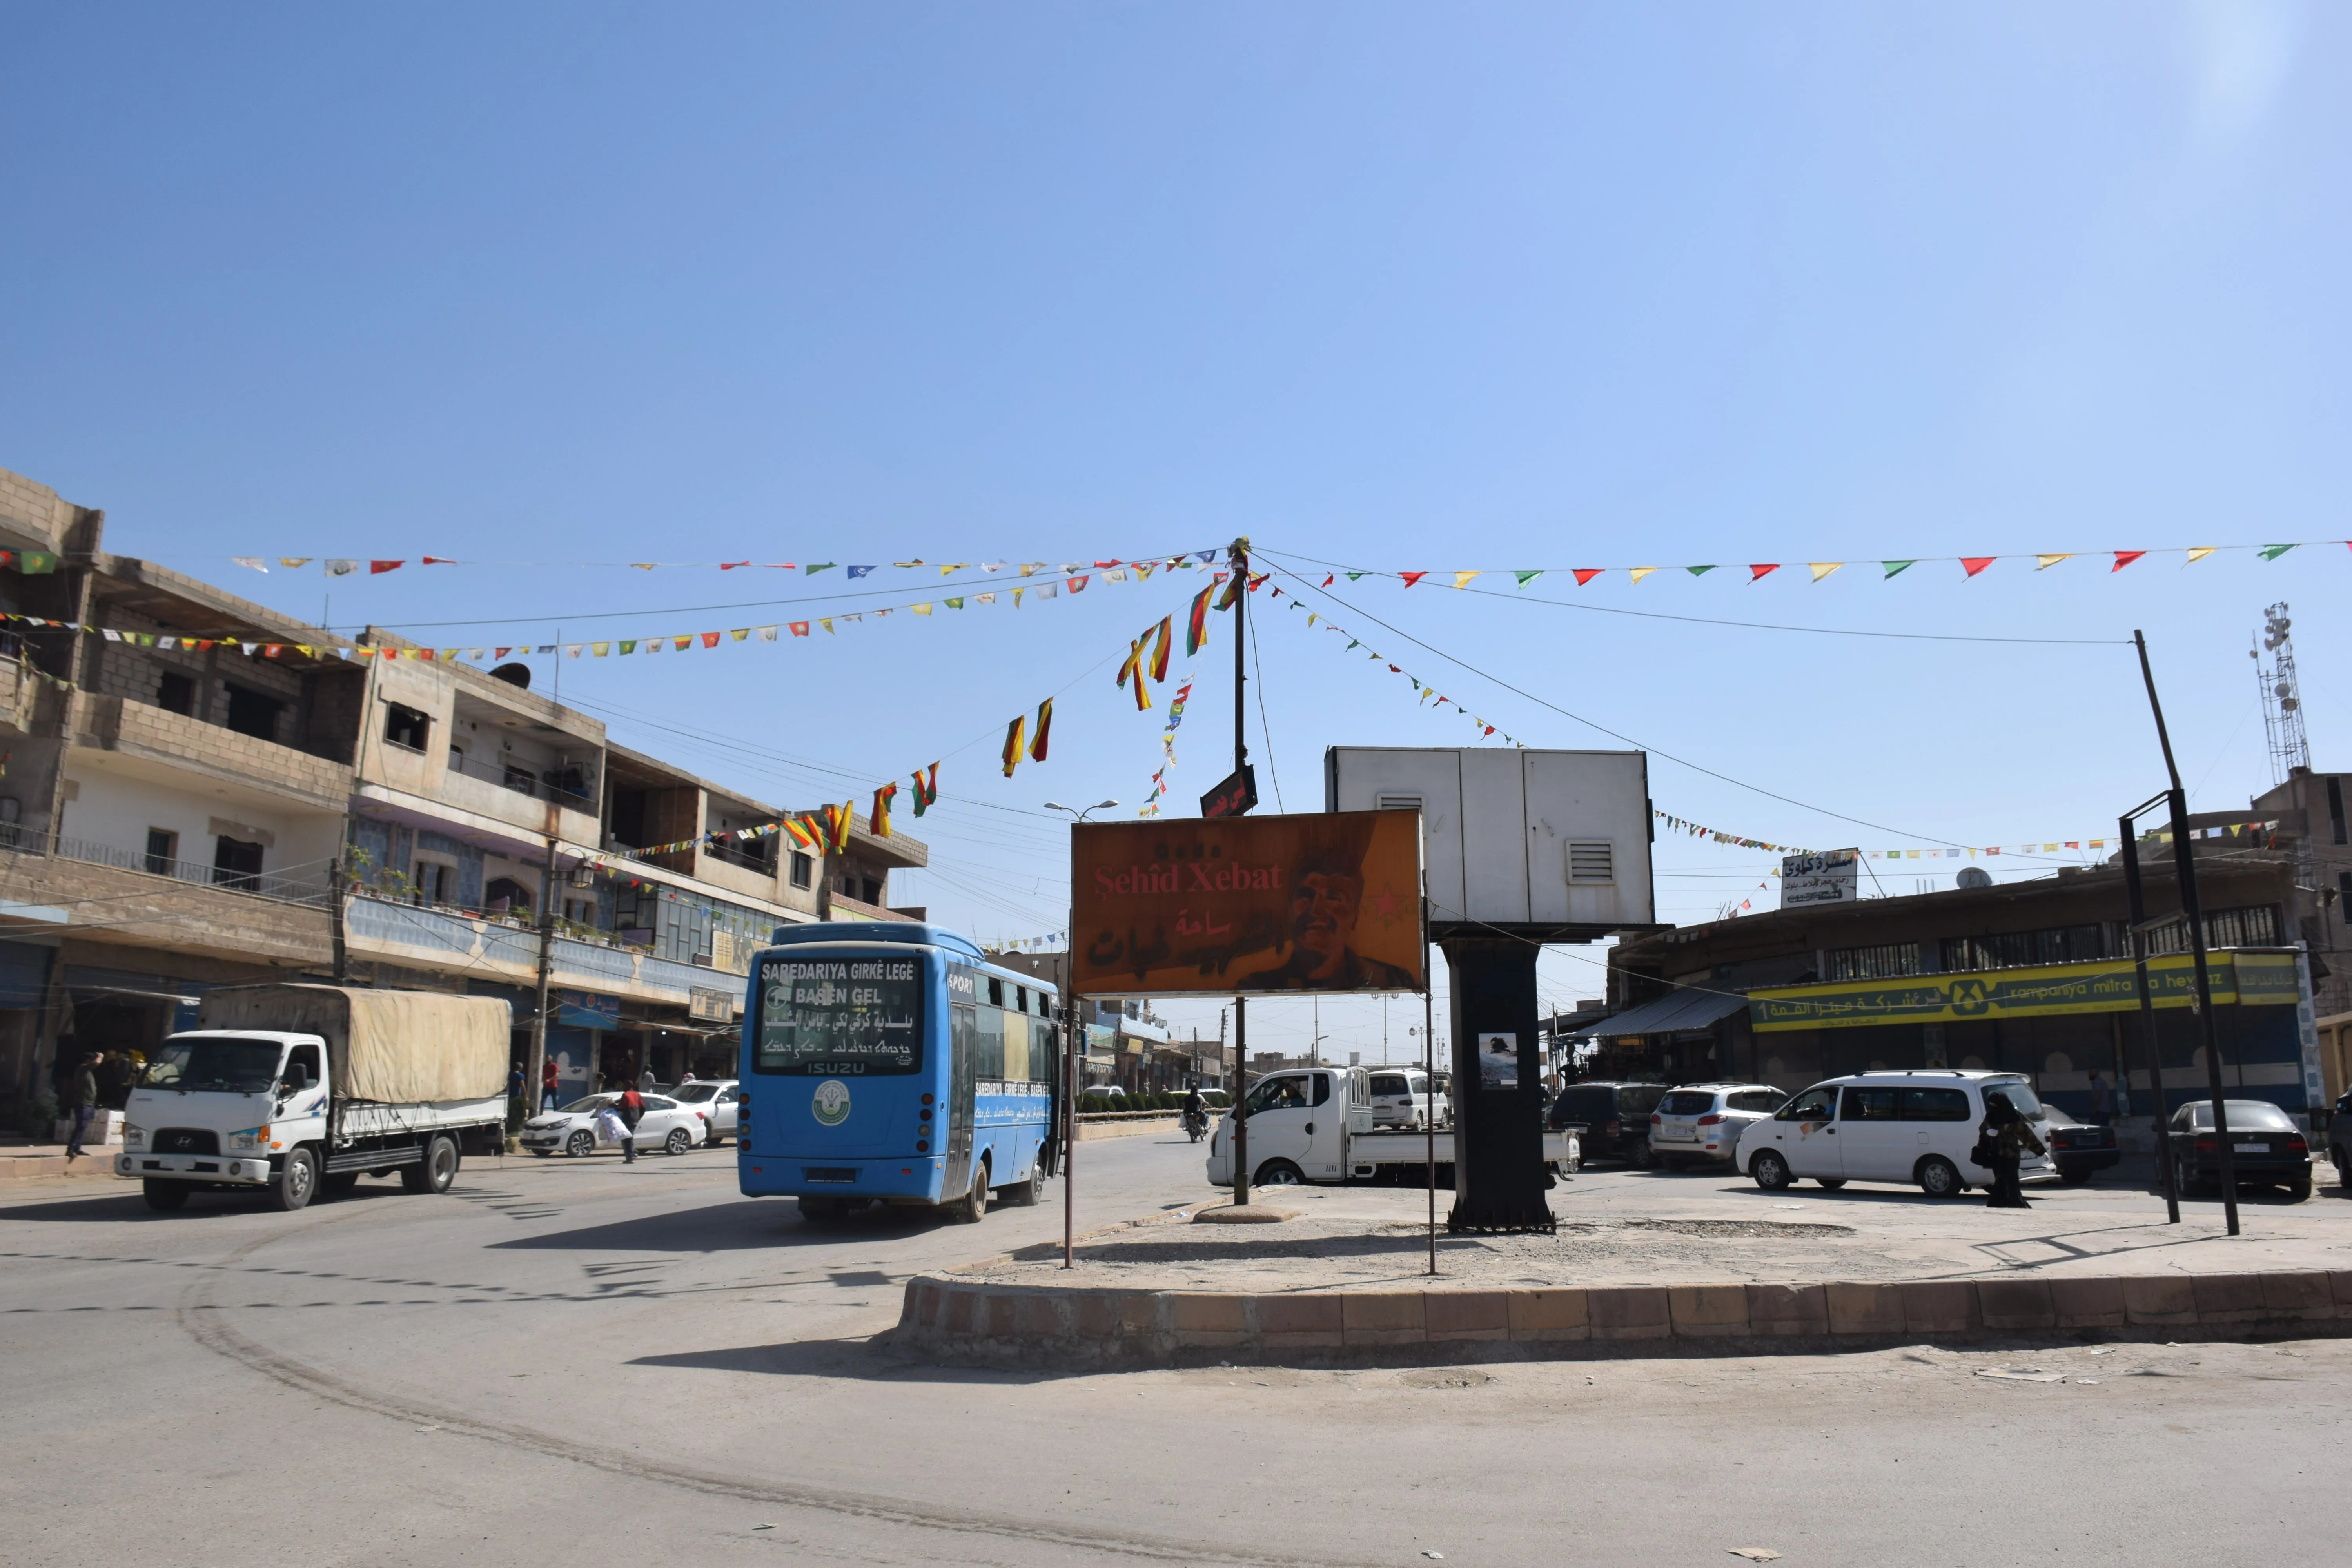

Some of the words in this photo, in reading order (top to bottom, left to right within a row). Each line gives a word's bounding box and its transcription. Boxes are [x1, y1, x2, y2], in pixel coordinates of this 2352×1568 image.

[1095, 863, 1180, 901] Şehîd
[1187, 861, 1282, 892] Xebat
[1175, 908, 1232, 936] ساحة
[851, 959, 883, 980] GIRKÊ
[886, 961, 913, 980] LEGÊ
[2094, 978, 2132, 993] mitra
[851, 988, 882, 1004] GEL
[1858, 993, 1916, 1012] شركة
[1914, 988, 1941, 1008] فرع
[1758, 1002, 1768, 1020] 1
[1770, 1003, 1811, 1017] القمة
[1815, 1001, 1853, 1016] ميترا
[764, 1010, 802, 1032] الشعب
[804, 1013, 823, 1032] باص
[832, 1012, 848, 1034] لكي
[849, 1012, 871, 1034] كركي
[874, 1011, 913, 1034] بلدية
[808, 1063, 865, 1074] ISUZU
